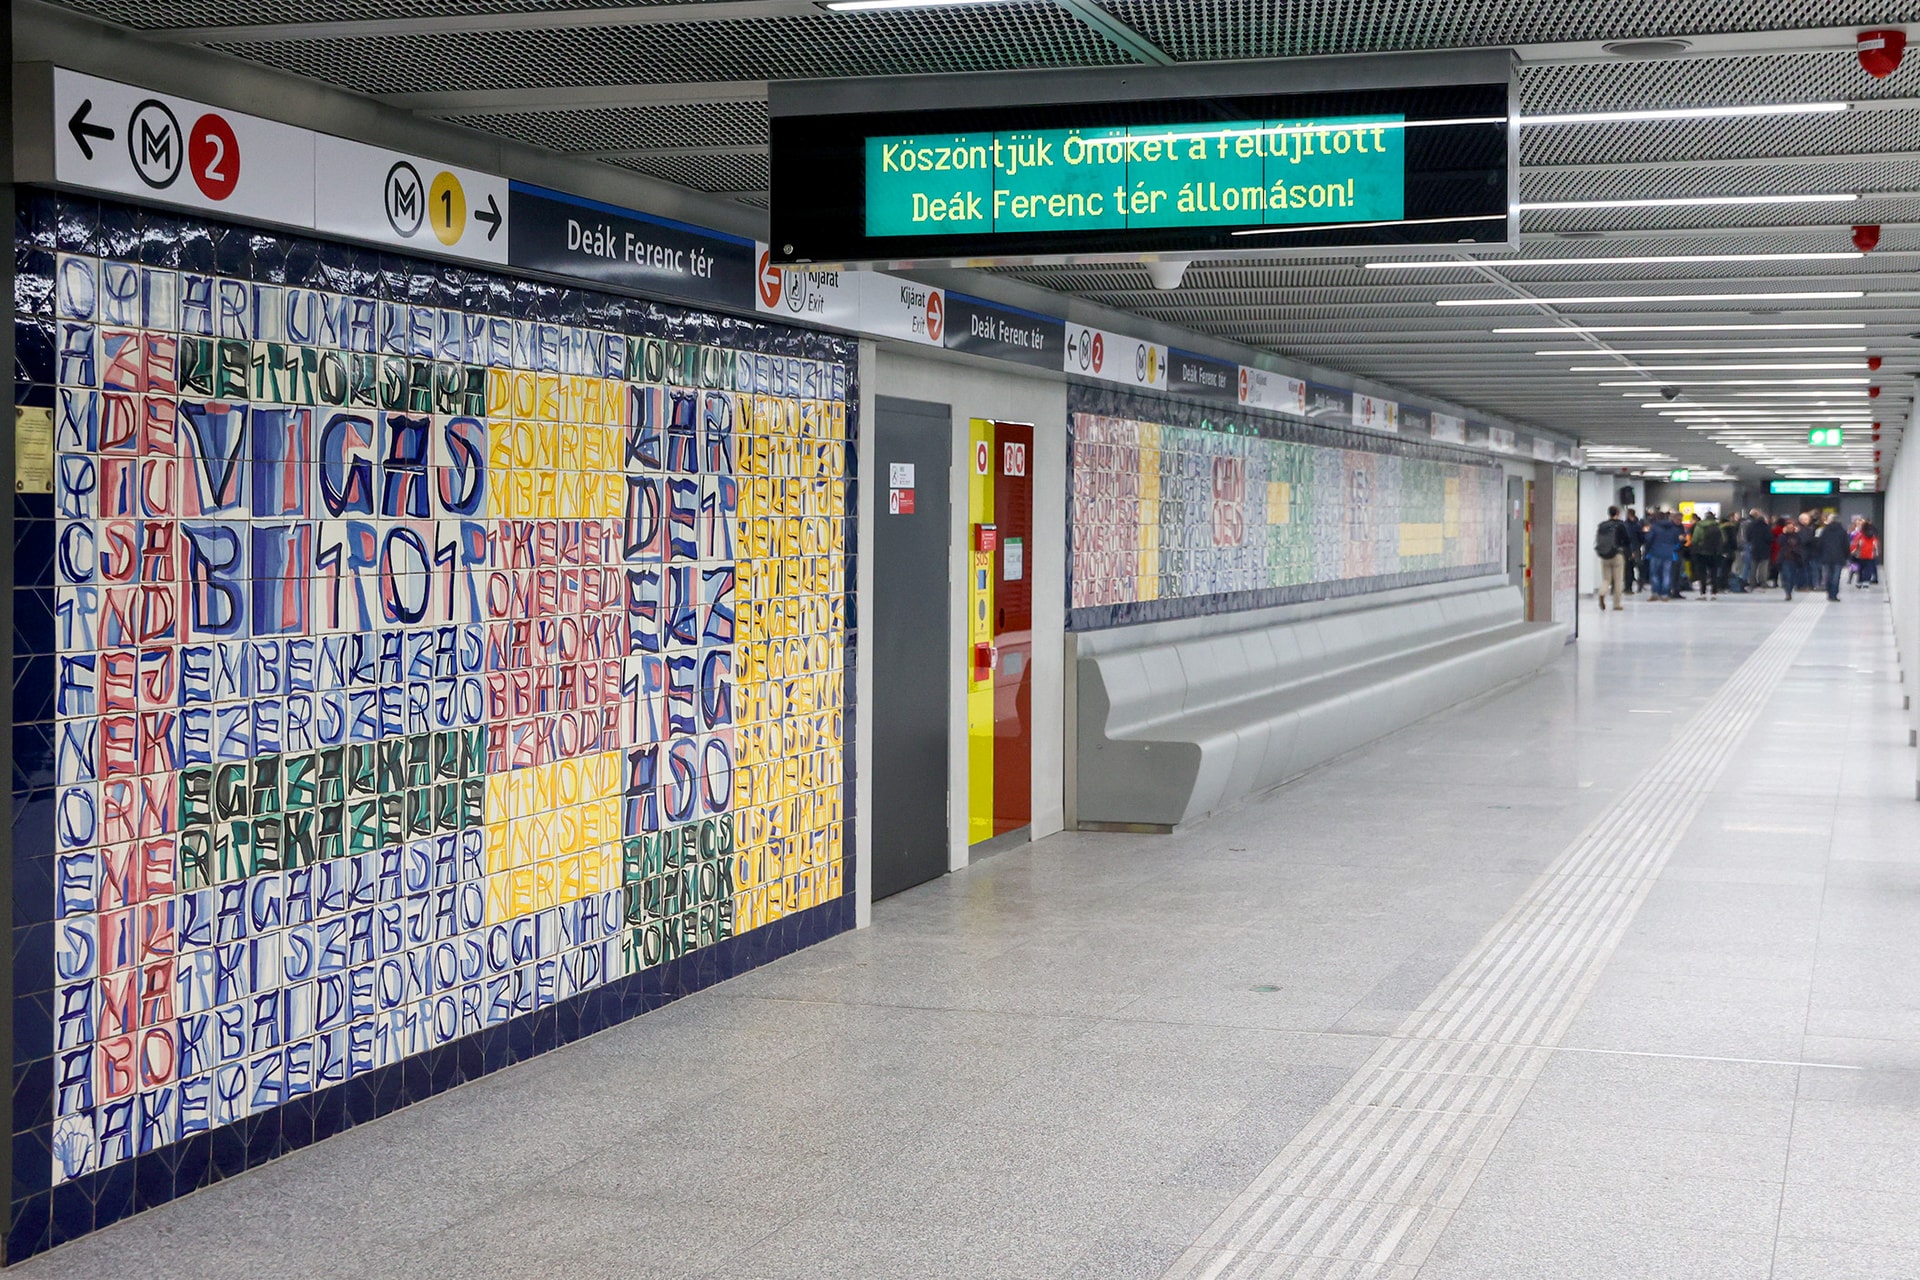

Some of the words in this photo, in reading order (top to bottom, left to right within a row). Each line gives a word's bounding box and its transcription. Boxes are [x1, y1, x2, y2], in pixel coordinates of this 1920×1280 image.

[203, 134, 226, 182] 2
[882, 134, 1054, 175] Köszöntjük
[1063, 129, 1179, 165] Önöket
[1187, 135, 1207, 160] a
[440, 189, 453, 229] 1
[912, 191, 983, 221] Deák
[993, 189, 1104, 219] Ferenc
[1112, 181, 1168, 215] tér
[1176, 178, 1354, 213] állomáson!
[567, 219, 617, 259] Deák
[625, 232, 684, 273] Ferenc
[689, 247, 715, 279] tér
[808, 293, 824, 314] Exit
[900, 286, 926, 310] Kijárat
[912, 315, 925, 335] Exit
[971, 314, 996, 340] Deák
[999, 320, 1028, 348] Ferenc
[1031, 327, 1044, 350] tér
